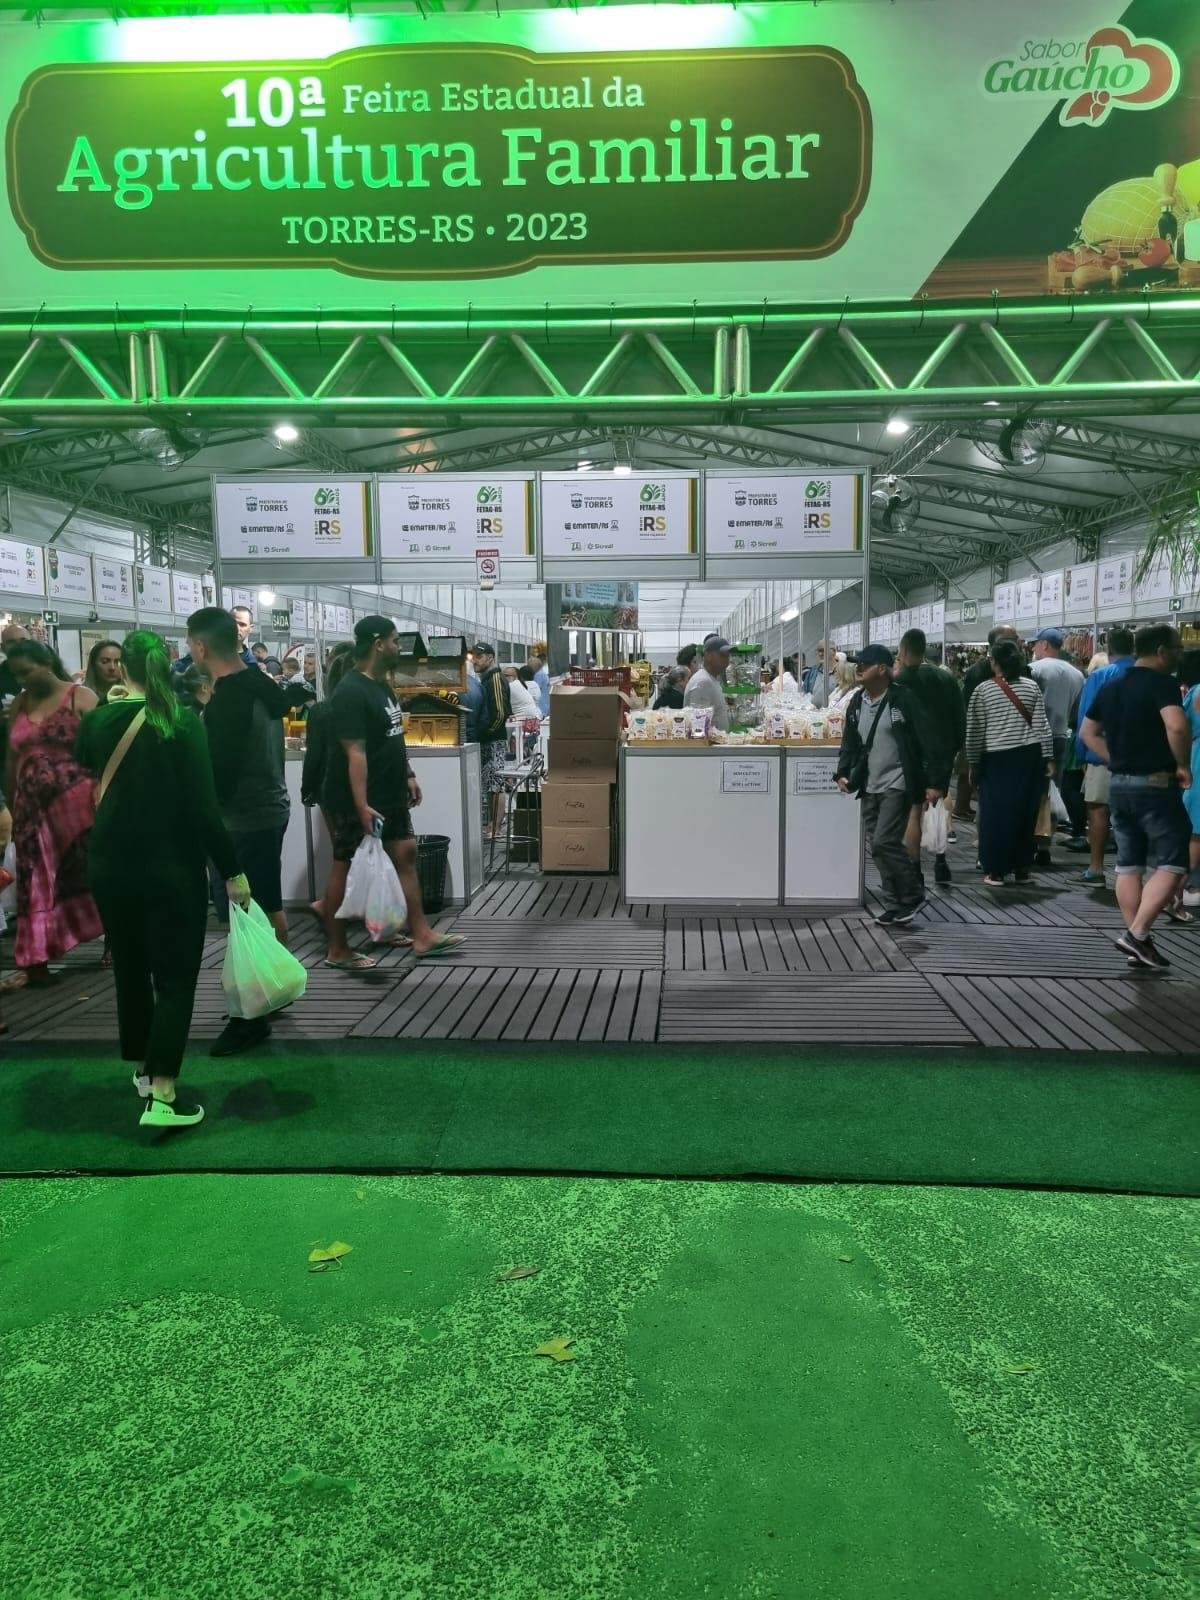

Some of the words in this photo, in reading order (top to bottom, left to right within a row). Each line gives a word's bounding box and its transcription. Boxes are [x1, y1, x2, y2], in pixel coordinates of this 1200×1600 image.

[1020, 38, 1087, 62] Sabor
[984, 48, 1134, 94] Gaúcho
[220, 75, 326, 128] 10ª
[342, 82, 432, 113] Feira
[441, 77, 594, 112] Estadual
[602, 76, 644, 108] da
[56, 127, 481, 210] Agricultura
[502, 117, 820, 186] Familiar
[282, 214, 474, 244] TORRES-RS
[506, 212, 588, 242] 2023
[319, 520, 341, 535] RS
[481, 518, 503, 534] RS
[644, 516, 666, 531] RS
[809, 513, 831, 528] RS
